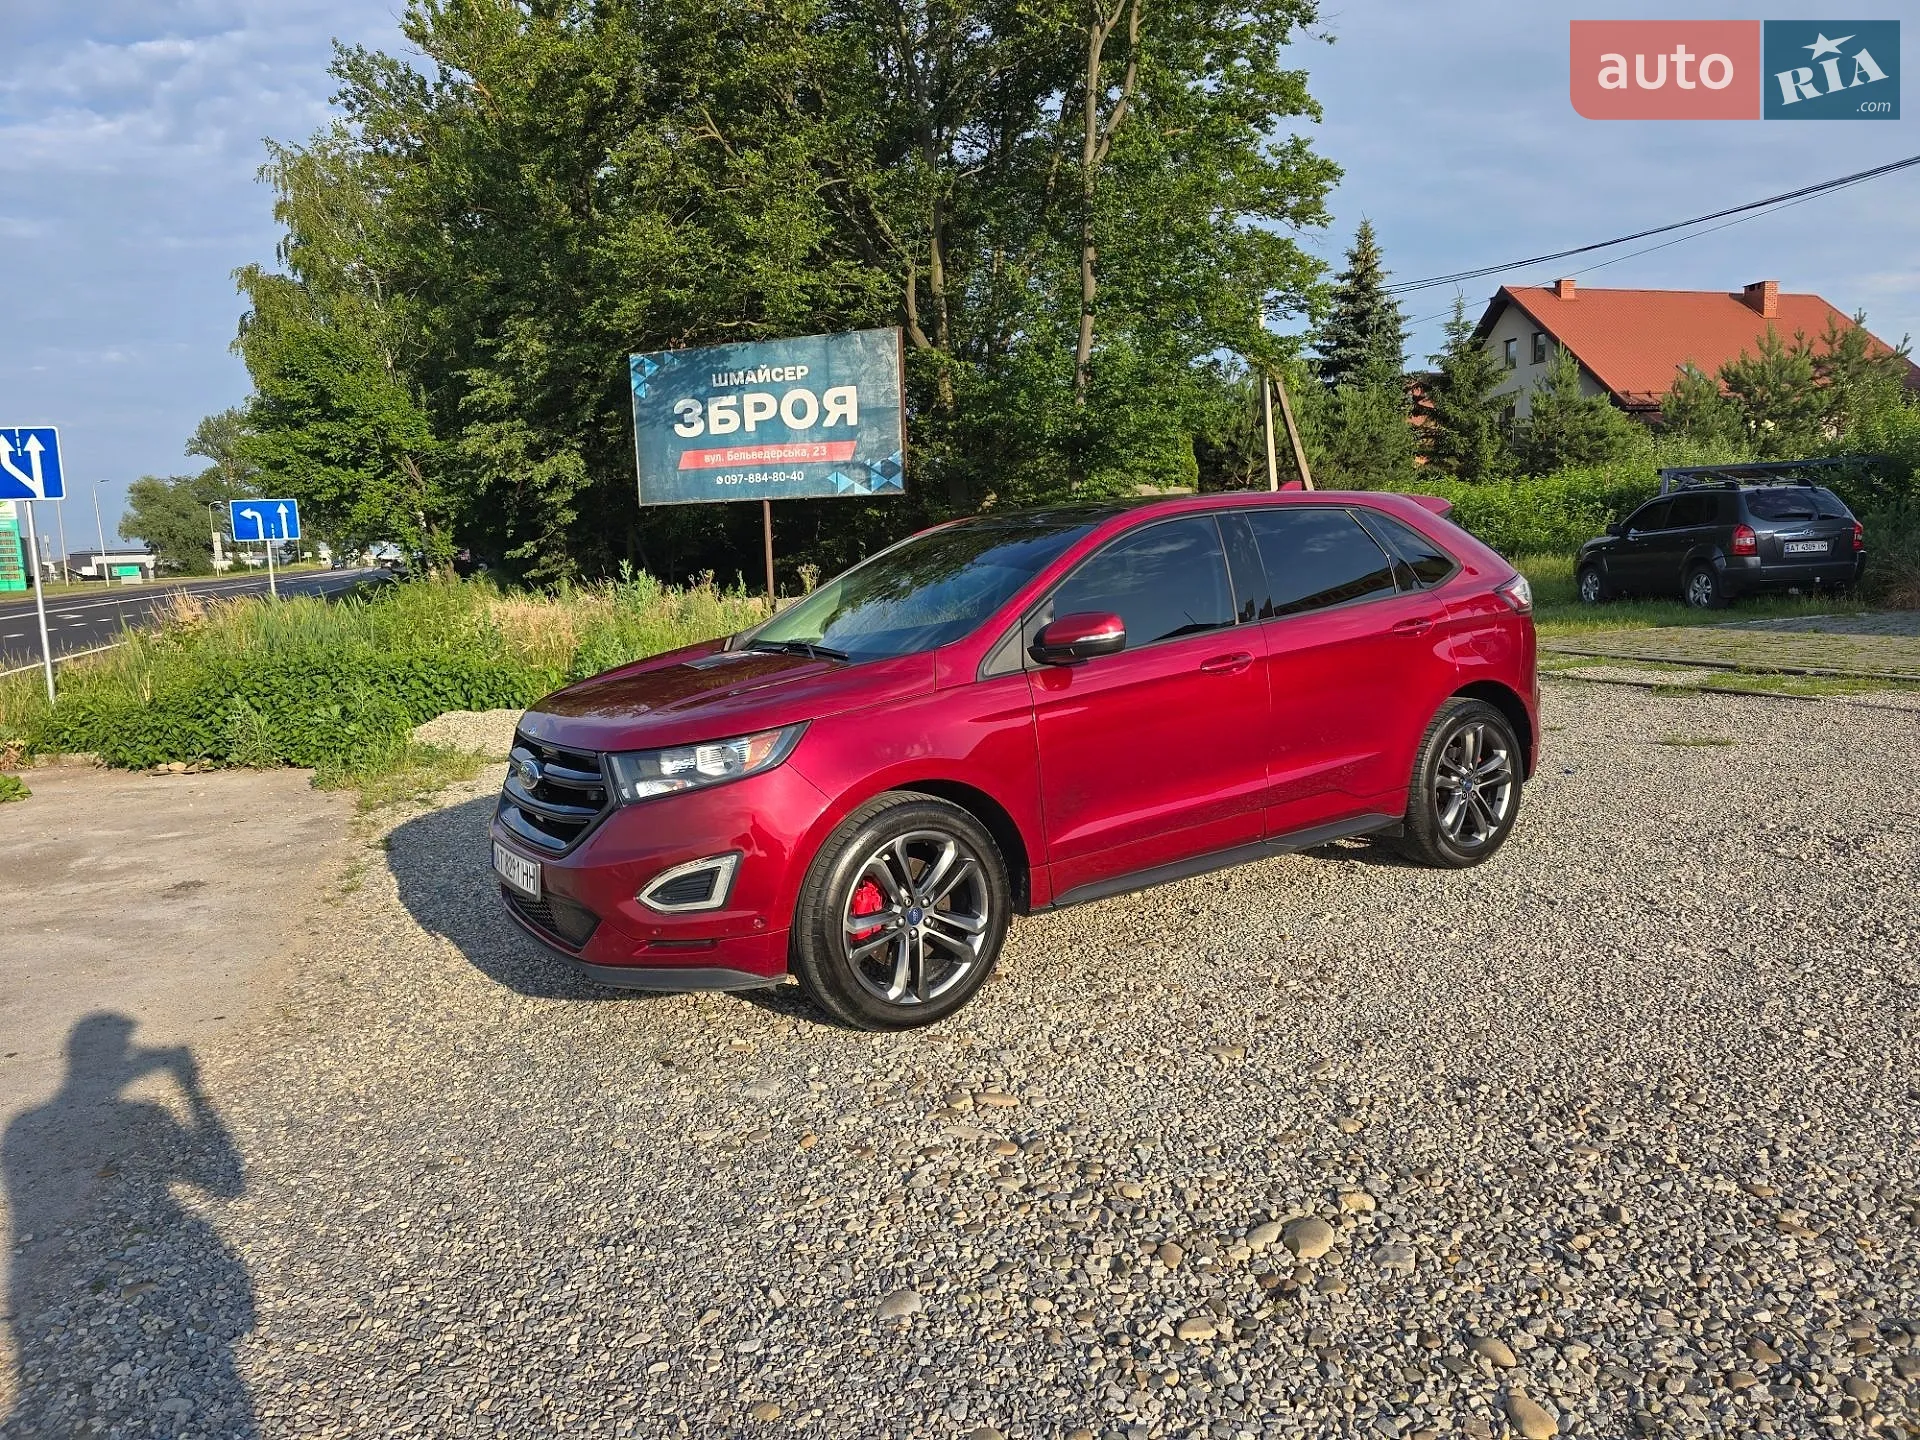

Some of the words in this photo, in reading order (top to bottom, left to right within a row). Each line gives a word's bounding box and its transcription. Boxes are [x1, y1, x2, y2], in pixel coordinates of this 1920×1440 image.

[712, 365, 809, 387] ШМАЙСЕР
[673, 386, 858, 438] ЗБРОЯ
[704, 453, 725, 465] вул.
[727, 447, 810, 461] Бельведерська,
[813, 445, 828, 457] 23
[724, 470, 804, 485] 097-884-80-40
[522, 862, 537, 891] HH
